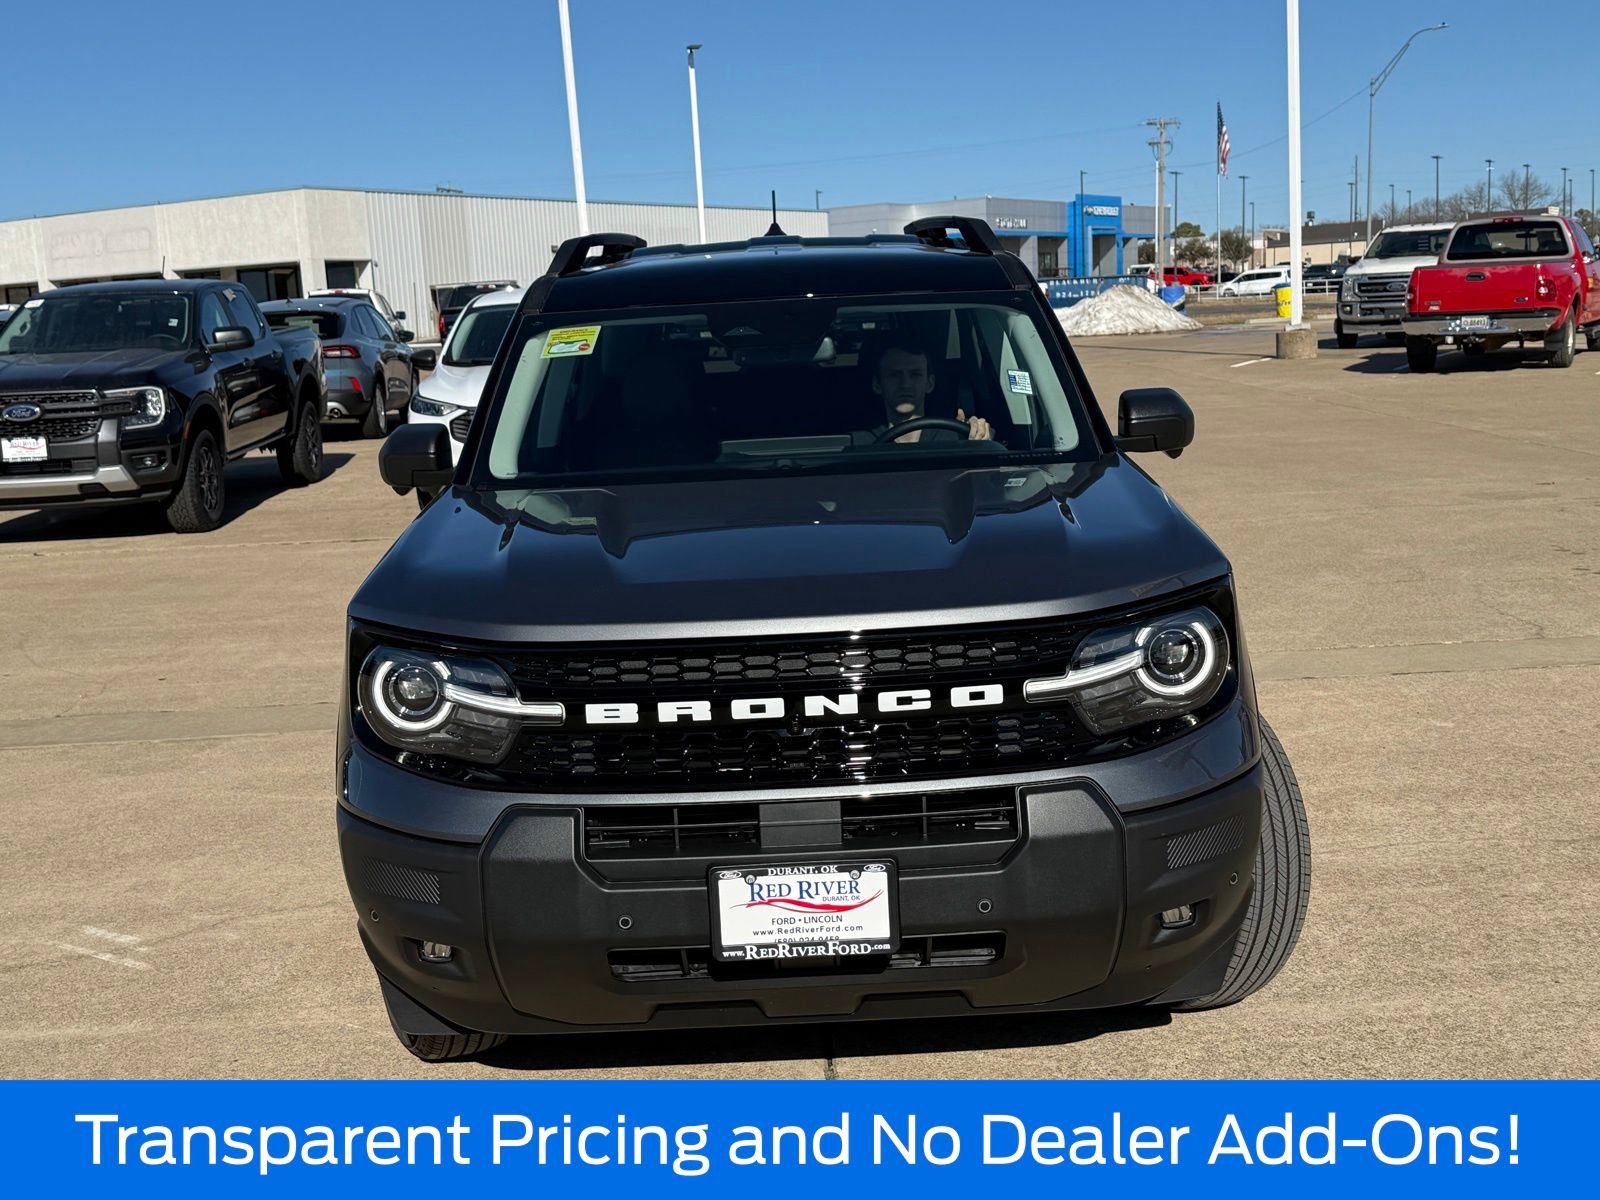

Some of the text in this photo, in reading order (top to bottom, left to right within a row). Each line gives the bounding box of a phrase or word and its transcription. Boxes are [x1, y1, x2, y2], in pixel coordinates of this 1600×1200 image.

[585, 684, 1003, 724] BRONCO
[767, 865, 838, 876] DURANT, OK
[750, 879, 861, 902] RED RIVER
[771, 915, 843, 925] FORD LINCOLN
[752, 925, 863, 936] www.RedRiverFord.com
